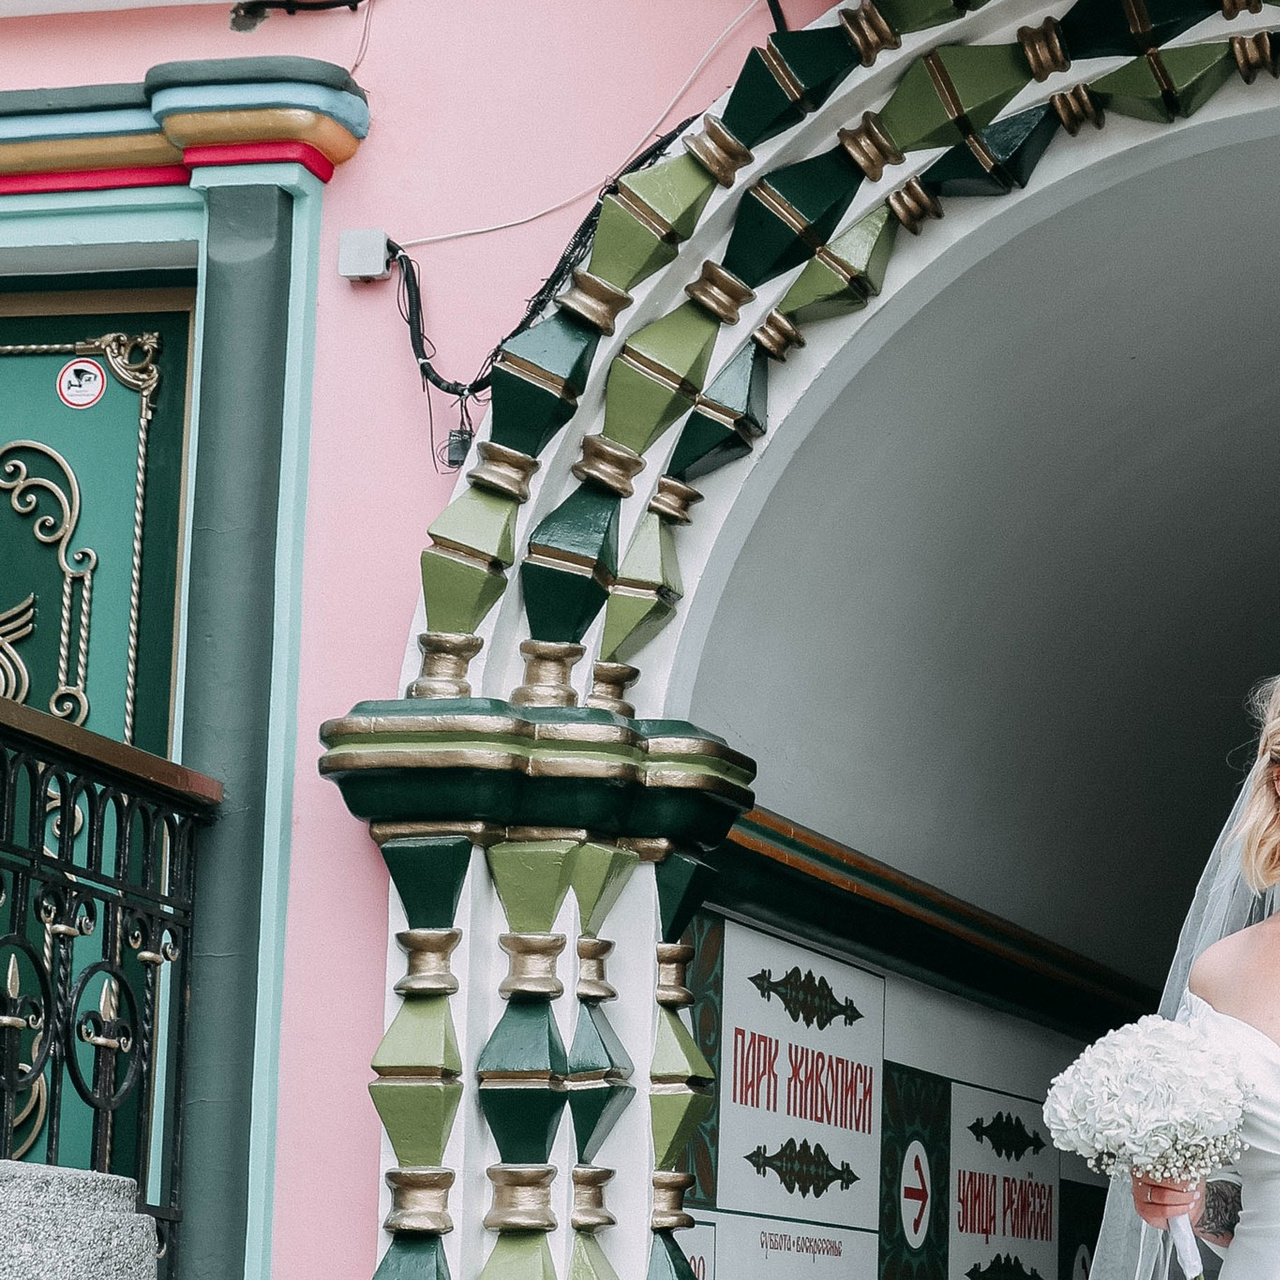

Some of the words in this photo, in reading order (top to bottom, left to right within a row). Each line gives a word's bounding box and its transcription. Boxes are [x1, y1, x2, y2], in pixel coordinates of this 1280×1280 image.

[732, 1026, 780, 1113] ПАРК
[786, 1042, 874, 1135] ЖИВОПИСИ
[957, 1169, 997, 1245] УЛИЦА
[1002, 1170, 1053, 1242] РЕМЁСЕЛ
